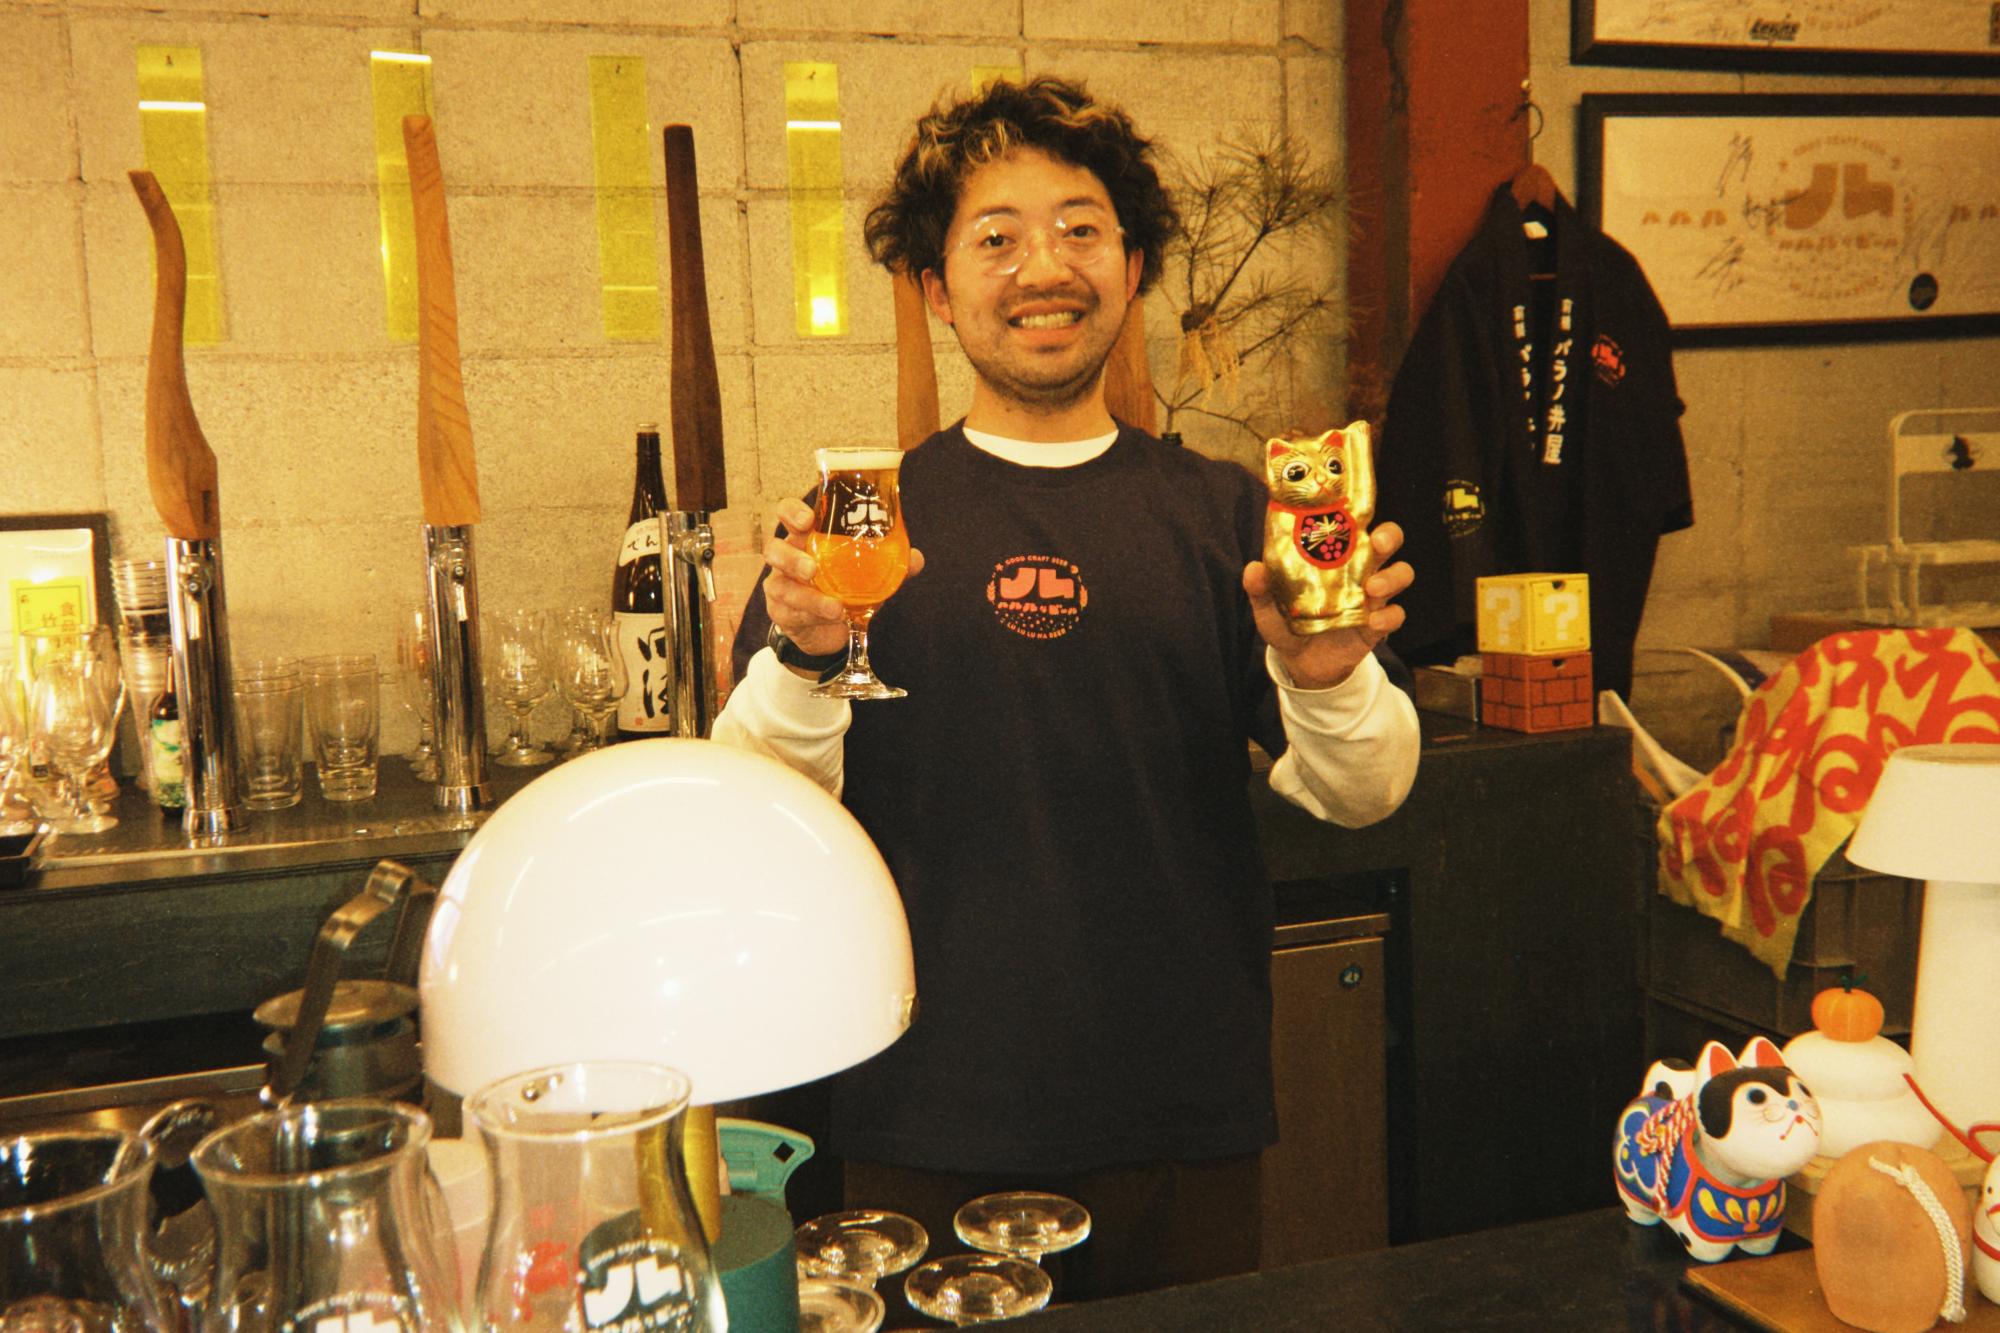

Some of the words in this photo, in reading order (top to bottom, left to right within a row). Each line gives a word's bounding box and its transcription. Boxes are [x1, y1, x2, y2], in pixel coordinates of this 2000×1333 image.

[1005, 556, 1025, 566] GOOD
[1027, 554, 1050, 562] CRAFT
[1051, 557, 1068, 566] BEER
